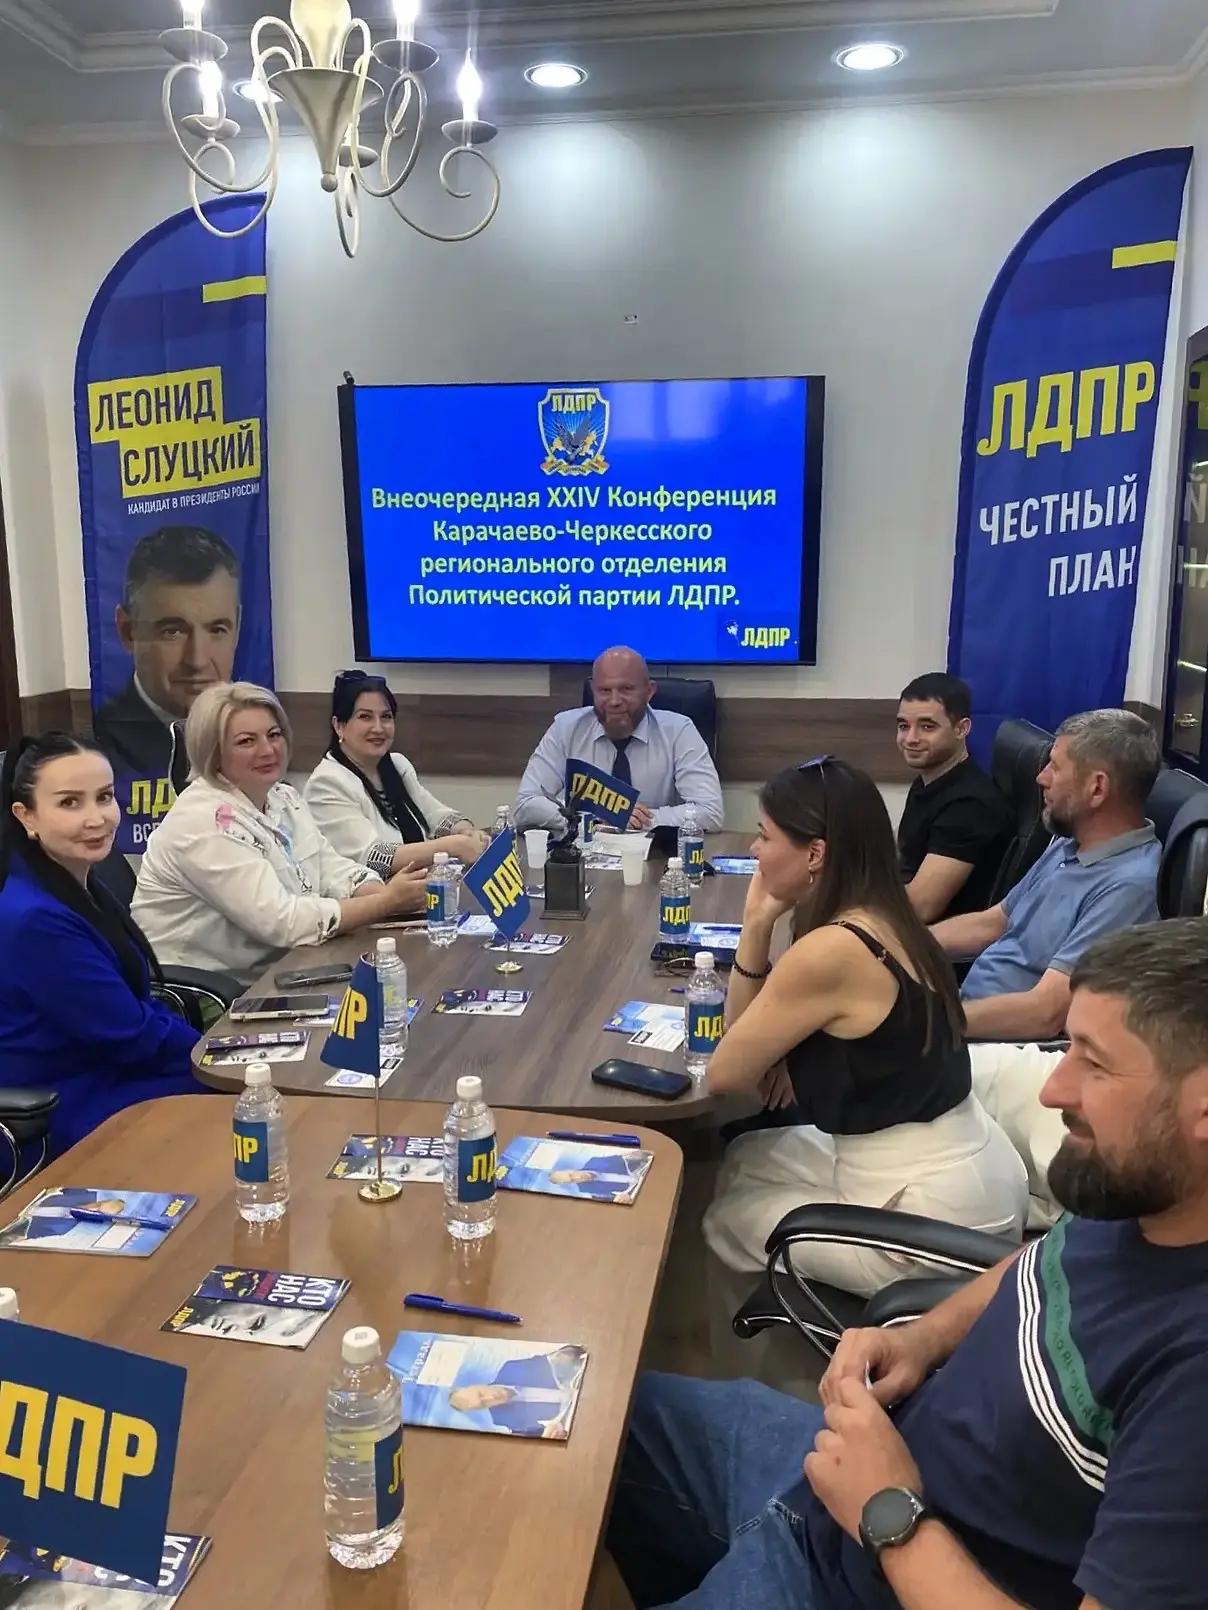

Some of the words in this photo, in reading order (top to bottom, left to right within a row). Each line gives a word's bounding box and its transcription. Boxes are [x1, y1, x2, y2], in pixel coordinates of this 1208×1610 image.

[95, 379, 216, 433] ЛЕОНИД
[551, 394, 596, 414] ЛДПР
[976, 361, 1156, 458] ЛДПР
[123, 422, 254, 487] СЛУЦКИЙ
[128, 498, 171, 515] КАНДИДАТ
[172, 497, 179, 509] В
[180, 488, 231, 507] ПРЕЗИДЕНТЫ
[232, 482, 260, 499] РОССИИ
[371, 487, 540, 514] Внеочередная
[547, 486, 600, 508] XXIV
[608, 484, 776, 513] Конференция
[979, 473, 1138, 545] ЧЕСТНЫЙ
[433, 520, 713, 546] Карачаево-Черкесского
[420, 556, 595, 578] регионального
[601, 556, 727, 578] отделения
[1048, 546, 1137, 597] ПЛАН
[409, 583, 572, 606] Политической
[578, 589, 661, 611] партии
[667, 584, 740, 611] ЛДПР.
[741, 627, 791, 649] ЛДПР
[268, 1275, 306, 1303] НАС
[297, 1278, 336, 1306] КТО
